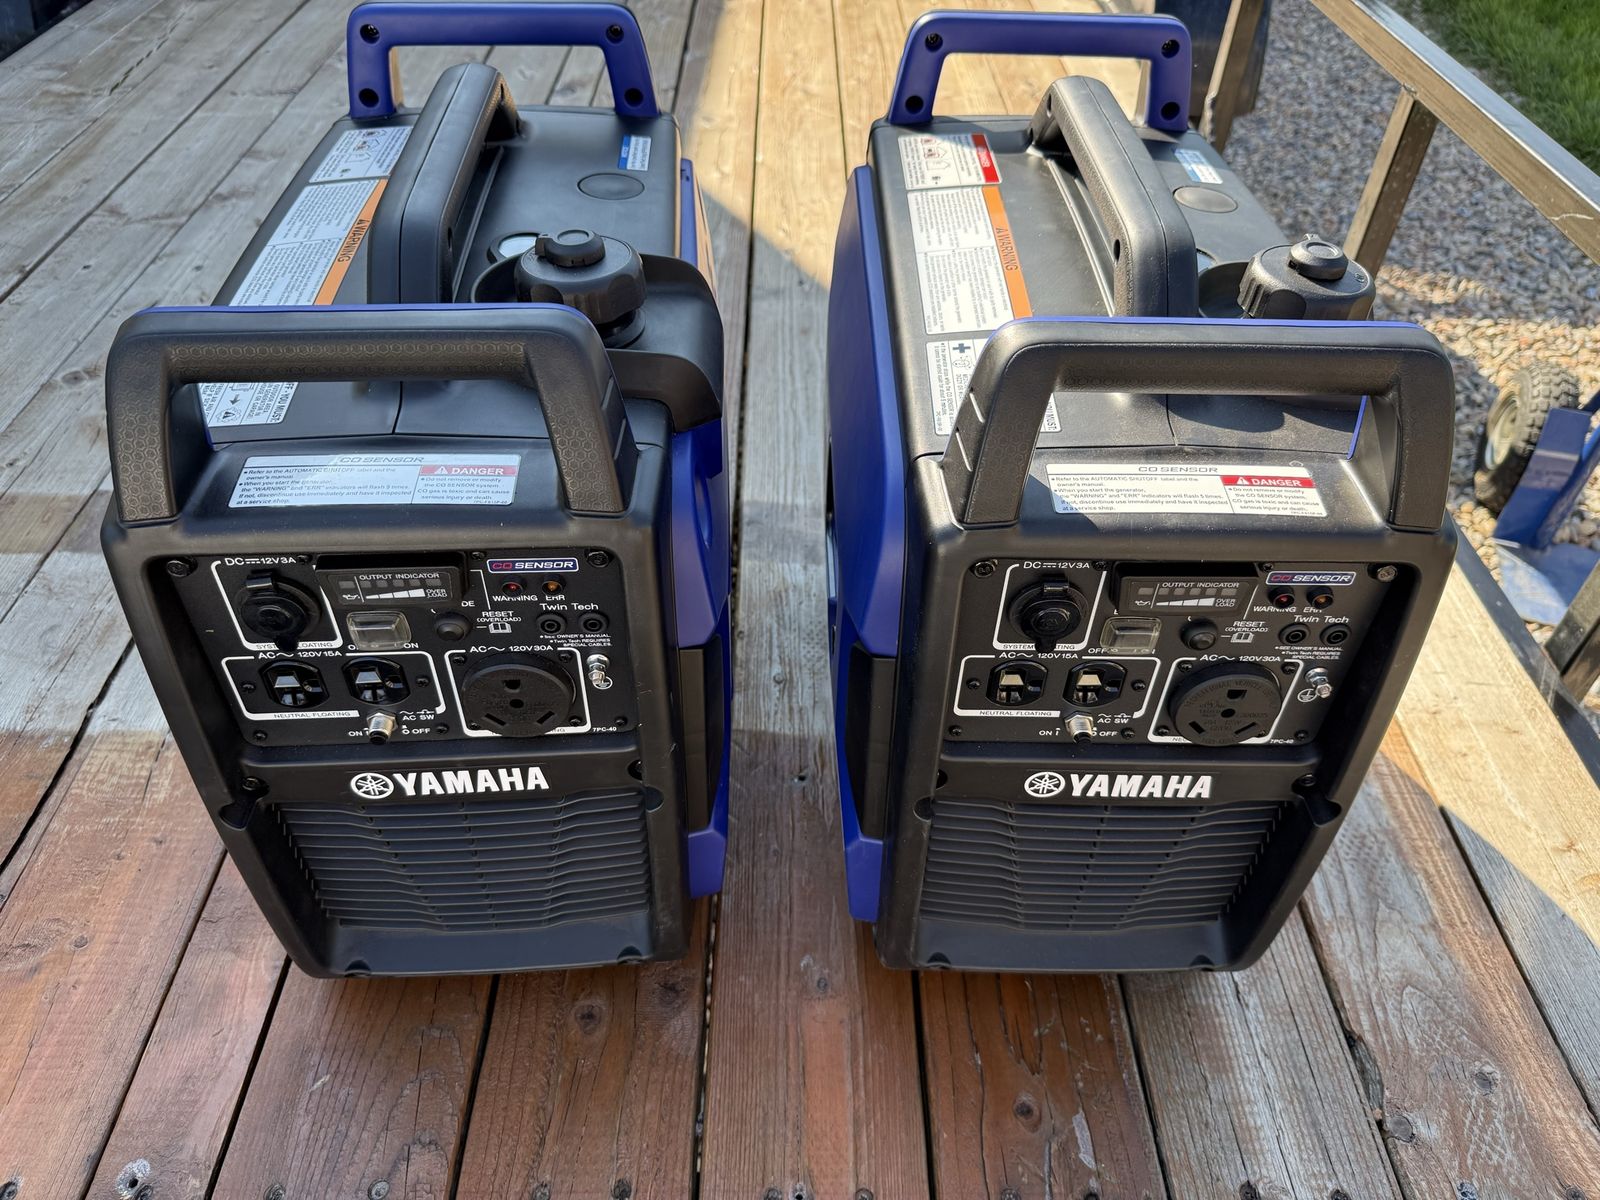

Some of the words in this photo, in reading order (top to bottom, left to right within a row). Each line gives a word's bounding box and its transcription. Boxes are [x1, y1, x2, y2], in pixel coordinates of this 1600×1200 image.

[337, 225, 367, 263] WARNING
[997, 233, 1019, 272] WARNING
[451, 467, 504, 475] DANGER
[1250, 478, 1303, 487] DANGER
[224, 557, 245, 566] DC
[491, 562, 513, 570] CO
[514, 561, 575, 569] SENSOR
[1023, 561, 1042, 569] DC
[358, 573, 393, 581] OUTPUT
[395, 572, 441, 580] INDICATOR
[539, 602, 568, 611] Twin
[570, 602, 599, 611] Tech
[1293, 614, 1320, 623] Twin
[1323, 615, 1350, 624] Tech
[1232, 620, 1266, 628] RESET
[469, 645, 487, 653] AC
[258, 651, 276, 660] AC
[998, 651, 1017, 659] AC
[419, 713, 435, 721] SW
[392, 766, 550, 797] YAMAHA
[1069, 773, 1213, 799] YAMAHA
